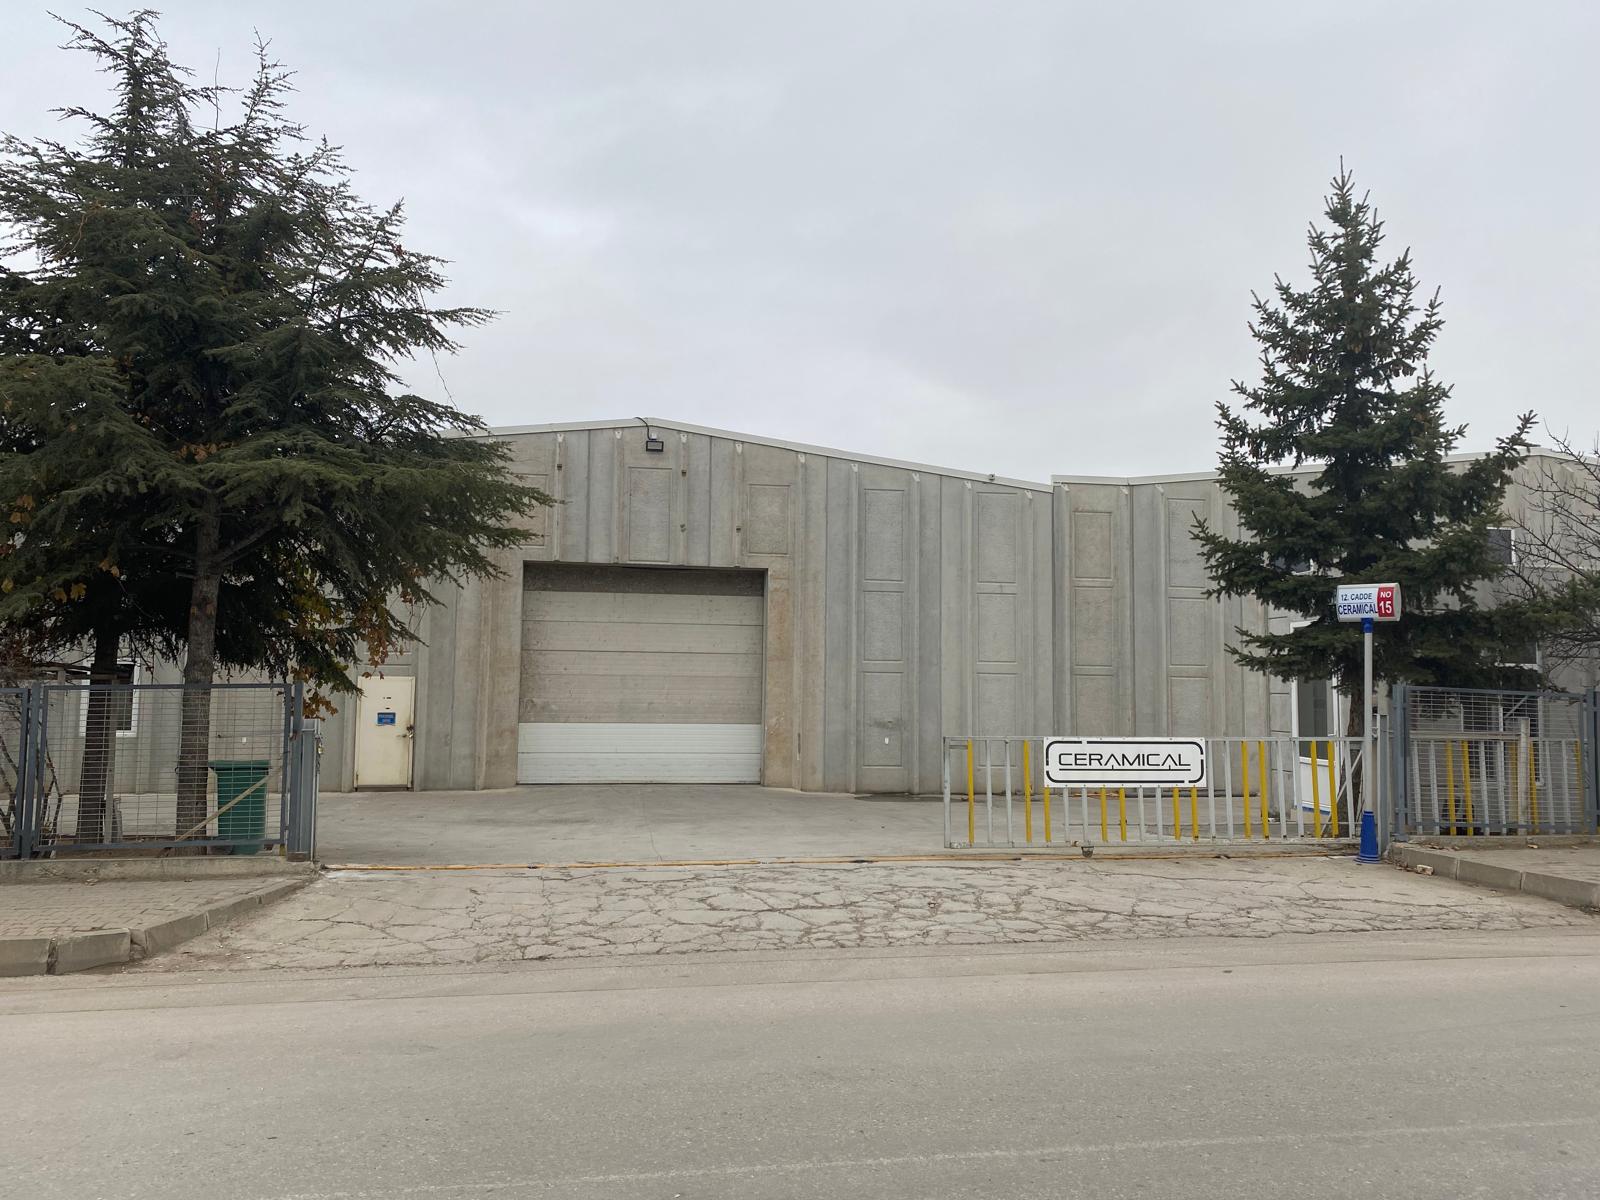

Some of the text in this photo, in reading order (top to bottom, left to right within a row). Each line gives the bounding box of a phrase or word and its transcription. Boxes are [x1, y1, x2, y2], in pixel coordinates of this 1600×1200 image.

[1350, 593, 1372, 601] CADDE
[1338, 603, 1378, 615] CERAMICAL
[1379, 601, 1392, 614] 15
[1058, 753, 1191, 767] CERAMICAL
